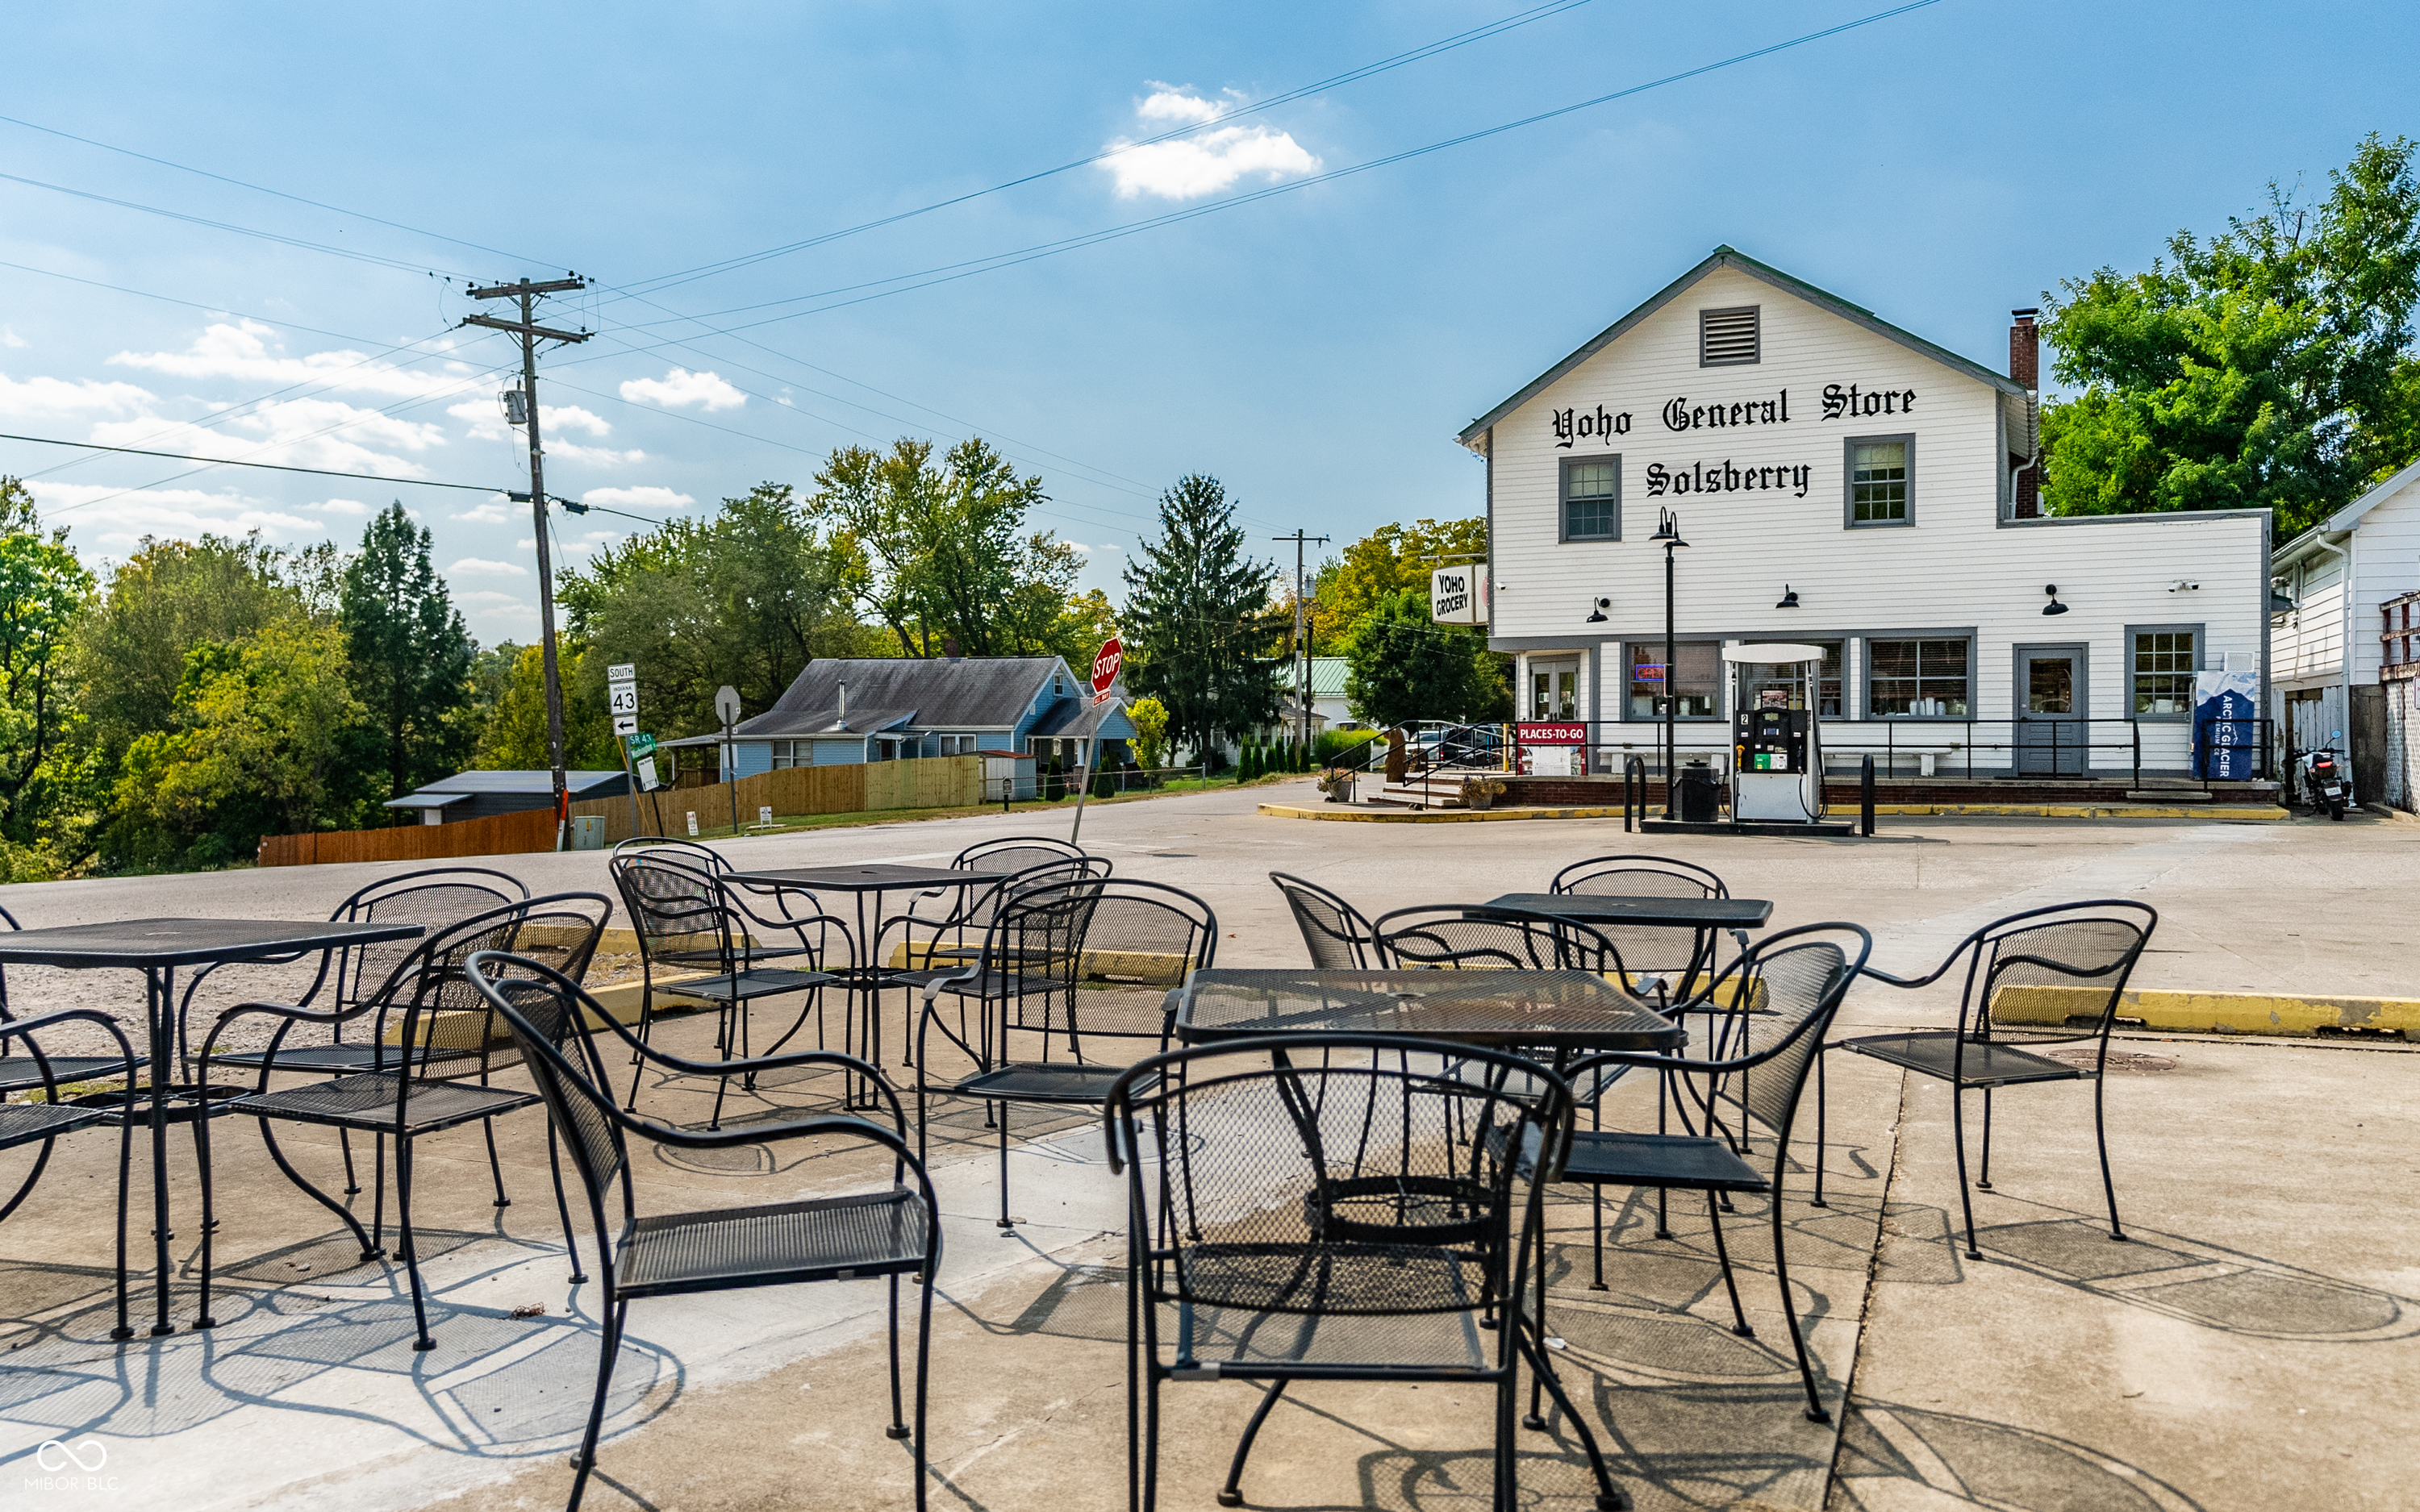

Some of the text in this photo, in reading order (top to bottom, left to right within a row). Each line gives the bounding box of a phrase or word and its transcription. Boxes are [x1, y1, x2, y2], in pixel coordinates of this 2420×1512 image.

[1552, 383, 1917, 448] Yoho General Store
[1646, 459, 1813, 498] Solsberry
[1438, 575, 1465, 594] YOHO
[1437, 594, 1468, 616] GROCERY
[610, 668, 633, 677] SOUTH
[1094, 652, 1120, 679] STOP
[613, 693, 635, 710] 43
[1742, 715, 1747, 724] 2
[630, 734, 651, 744] SR 43
[1520, 729, 1583, 739] PLACES-TO-GO
[2220, 695, 2233, 777] ARCTIC GLACIER
